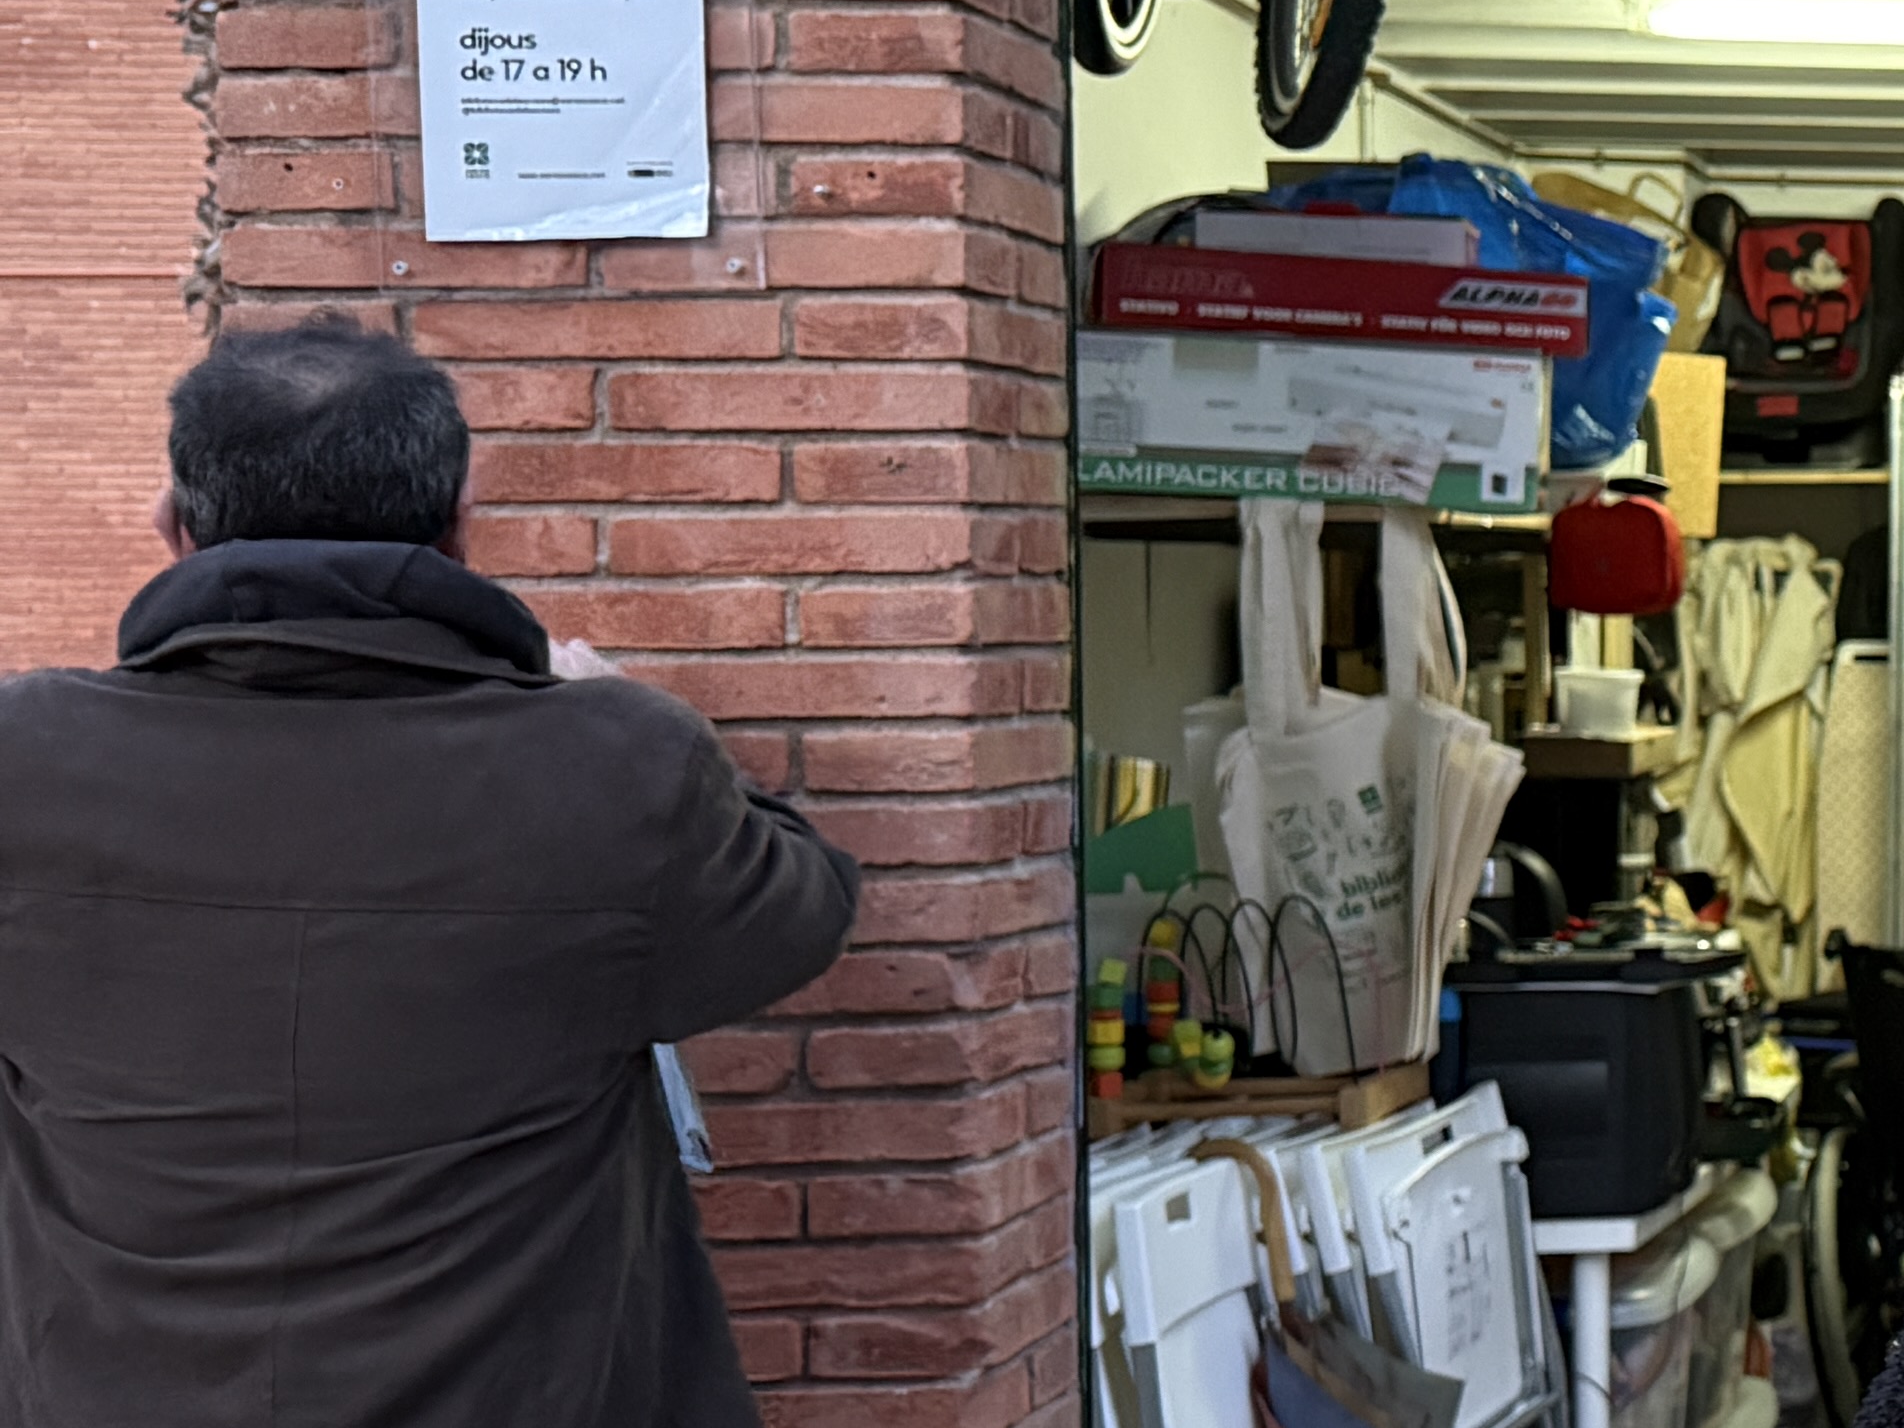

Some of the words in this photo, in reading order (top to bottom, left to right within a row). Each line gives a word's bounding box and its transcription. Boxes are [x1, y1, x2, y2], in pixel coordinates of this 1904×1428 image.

[459, 27, 537, 56] dijous
[460, 58, 495, 81] de
[501, 59, 525, 81] 17
[532, 65, 550, 81] a
[557, 58, 582, 81] 19
[590, 57, 607, 81] h
[1078, 458, 1288, 490] LAMIPACKER
